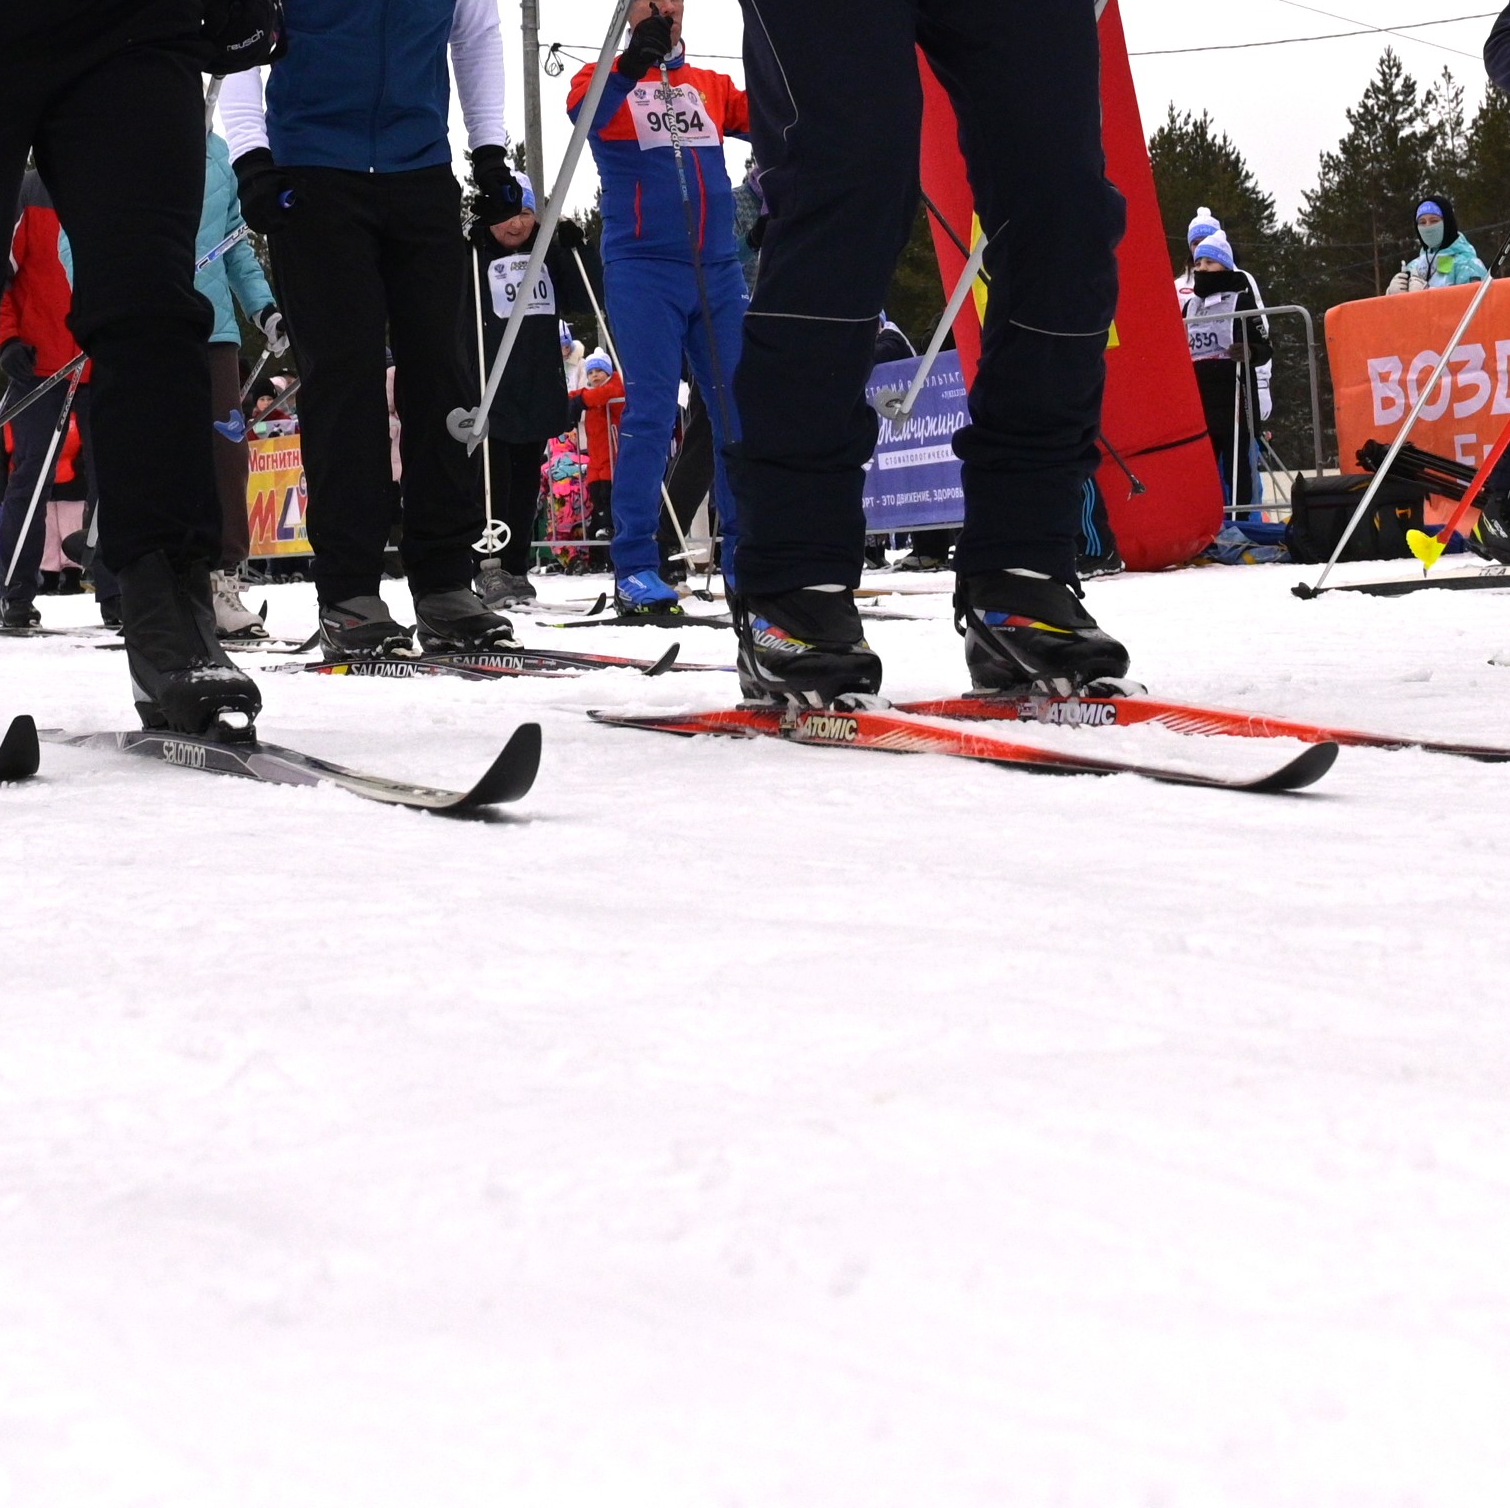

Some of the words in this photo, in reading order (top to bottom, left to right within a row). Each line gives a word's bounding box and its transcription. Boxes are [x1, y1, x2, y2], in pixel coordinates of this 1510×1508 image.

[226, 29, 265, 51] reusch
[647, 110, 705, 134] 9054
[666, 103, 683, 159] NORDWAY
[881, 494, 895, 506] ЭТО
[350, 663, 419, 678] SALOMON
[451, 655, 525, 670] SALOMON
[1046, 702, 1117, 726] ATOMIC
[802, 715, 858, 742] ATOMIC
[162, 740, 207, 769] salomon
